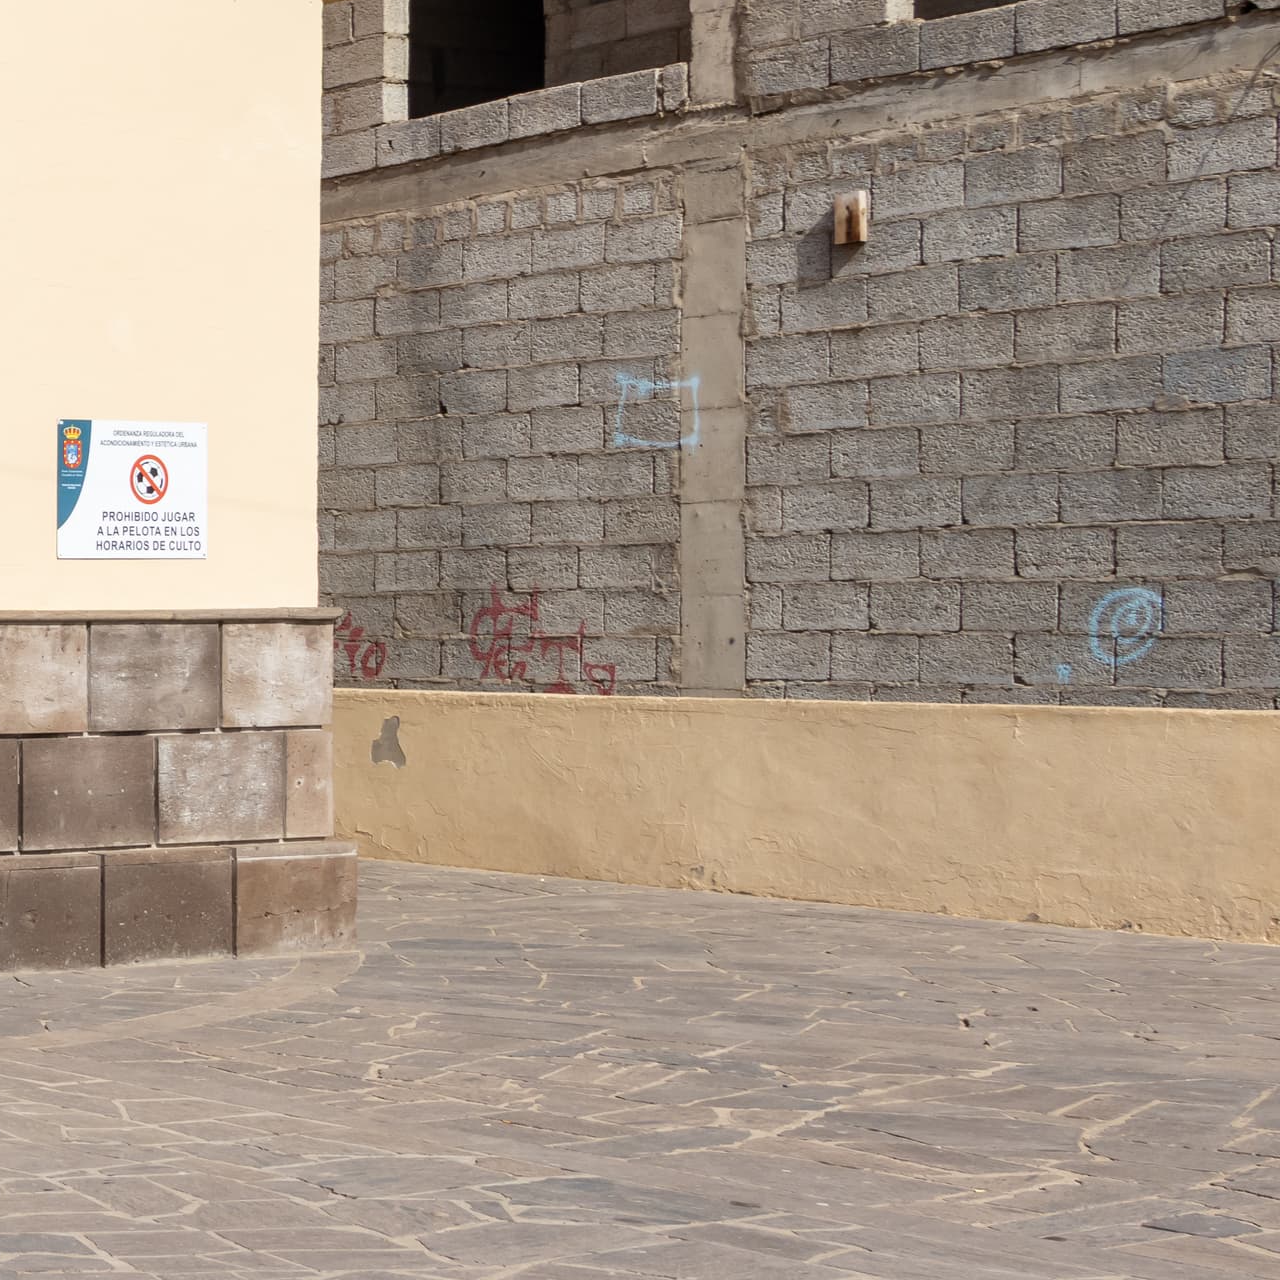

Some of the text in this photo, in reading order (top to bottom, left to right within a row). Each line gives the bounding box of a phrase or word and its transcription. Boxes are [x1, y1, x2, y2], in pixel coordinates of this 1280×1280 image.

[102, 511, 195, 522] PROHIBIDO JUGAR
[97, 526, 200, 536] A LA PELOTA EN LOS
[96, 540, 201, 551] HORARIOS DE CULTO
